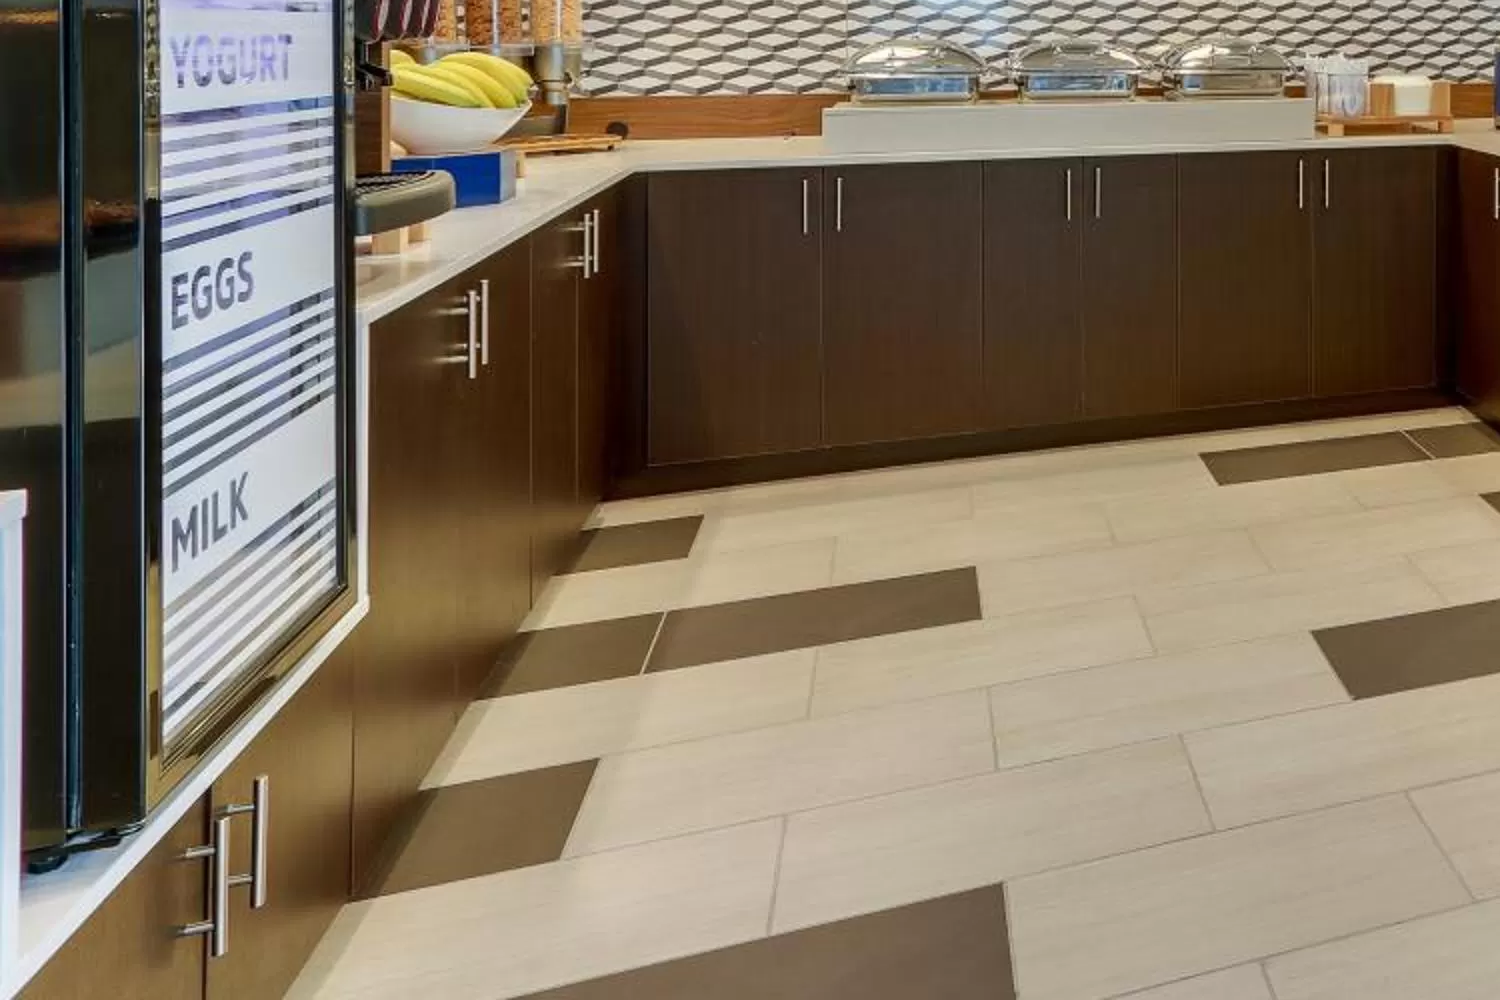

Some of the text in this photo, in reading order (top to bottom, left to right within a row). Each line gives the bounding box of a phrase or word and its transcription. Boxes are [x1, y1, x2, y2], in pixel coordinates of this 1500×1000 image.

[170, 35, 293, 89] YOGURT
[171, 251, 254, 331] EGGS
[172, 471, 249, 572] MILK
